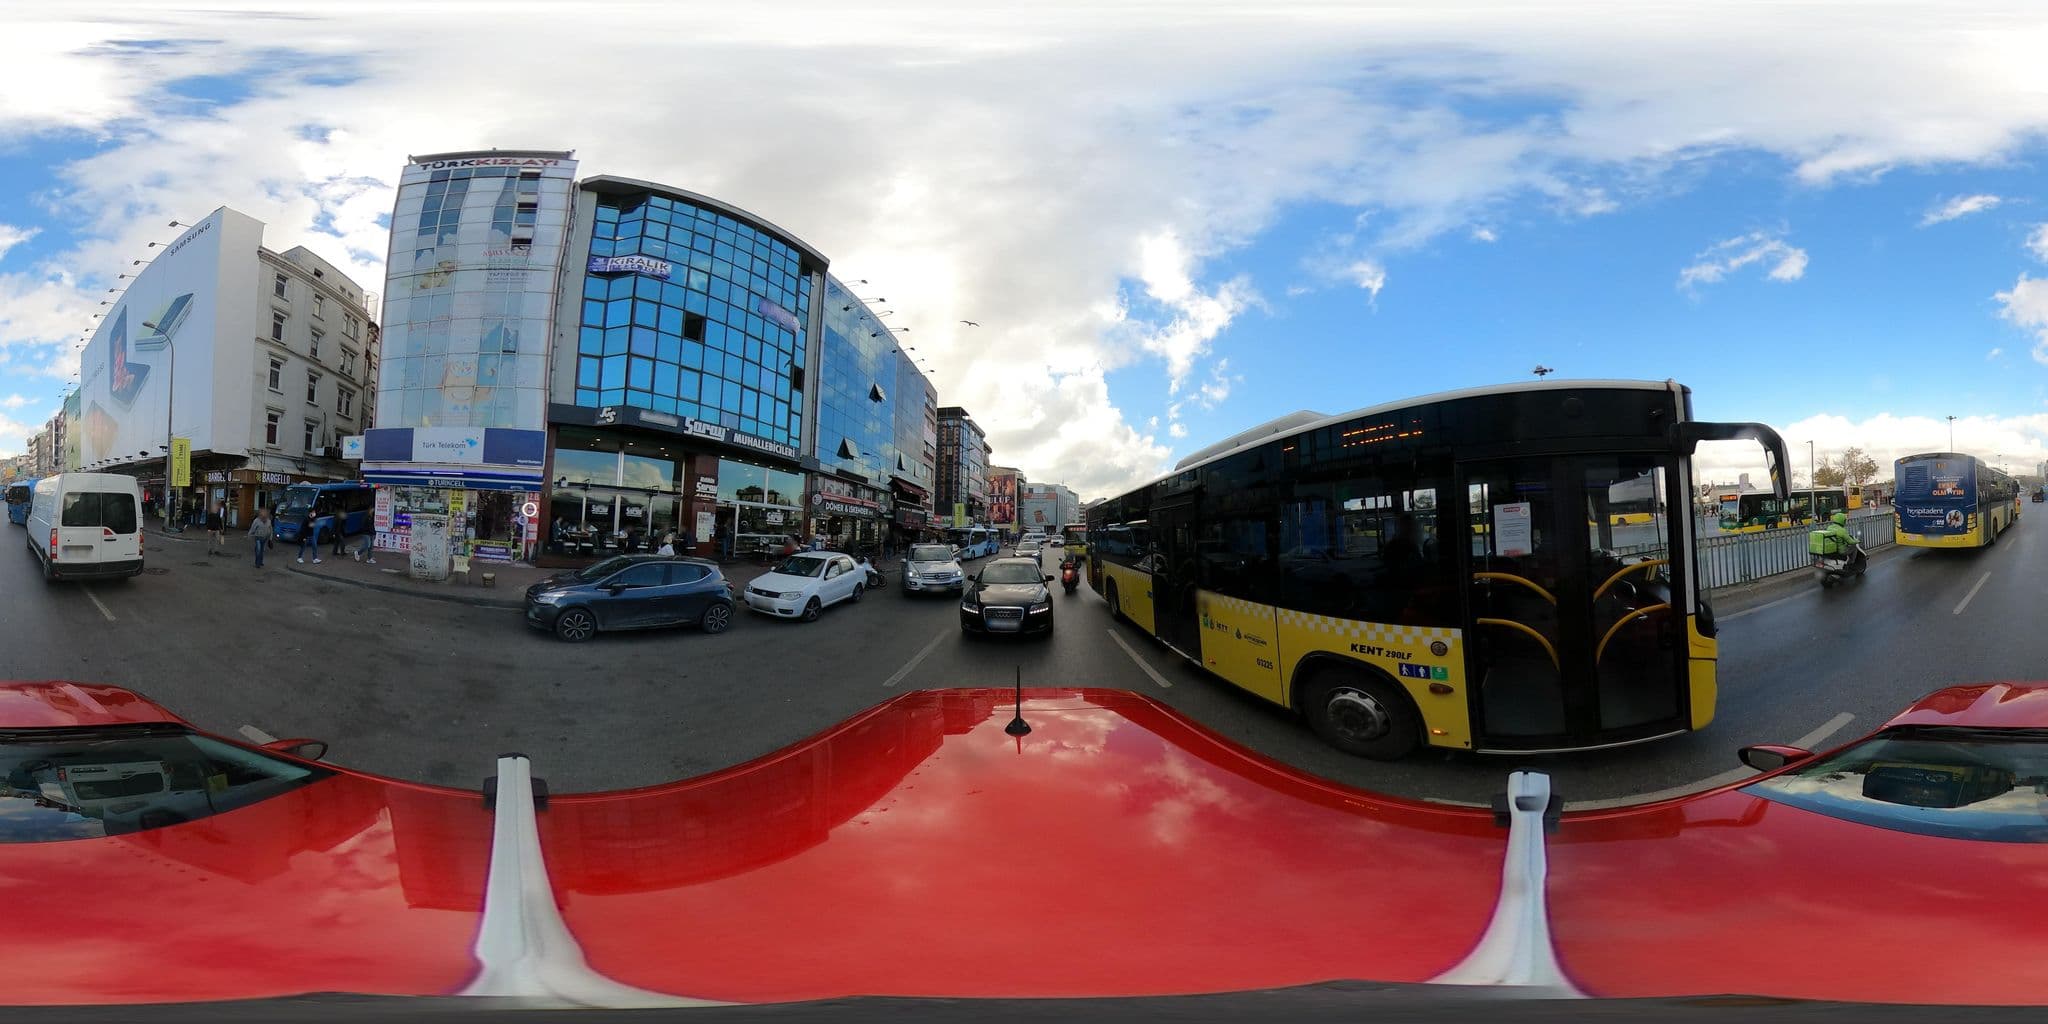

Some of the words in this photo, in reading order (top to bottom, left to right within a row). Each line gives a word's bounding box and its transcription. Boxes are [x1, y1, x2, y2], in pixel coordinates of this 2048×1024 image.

[170, 222, 211, 257] SAMSUNG
[684, 417, 725, 442] Saray
[422, 440, 436, 449] Türk
[438, 441, 466, 450] Telekom
[207, 471, 232, 482] BARGELO
[262, 472, 291, 485] BARGELLO
[1350, 643, 1384, 656] KENT
[1385, 650, 1412, 660] 290LF
